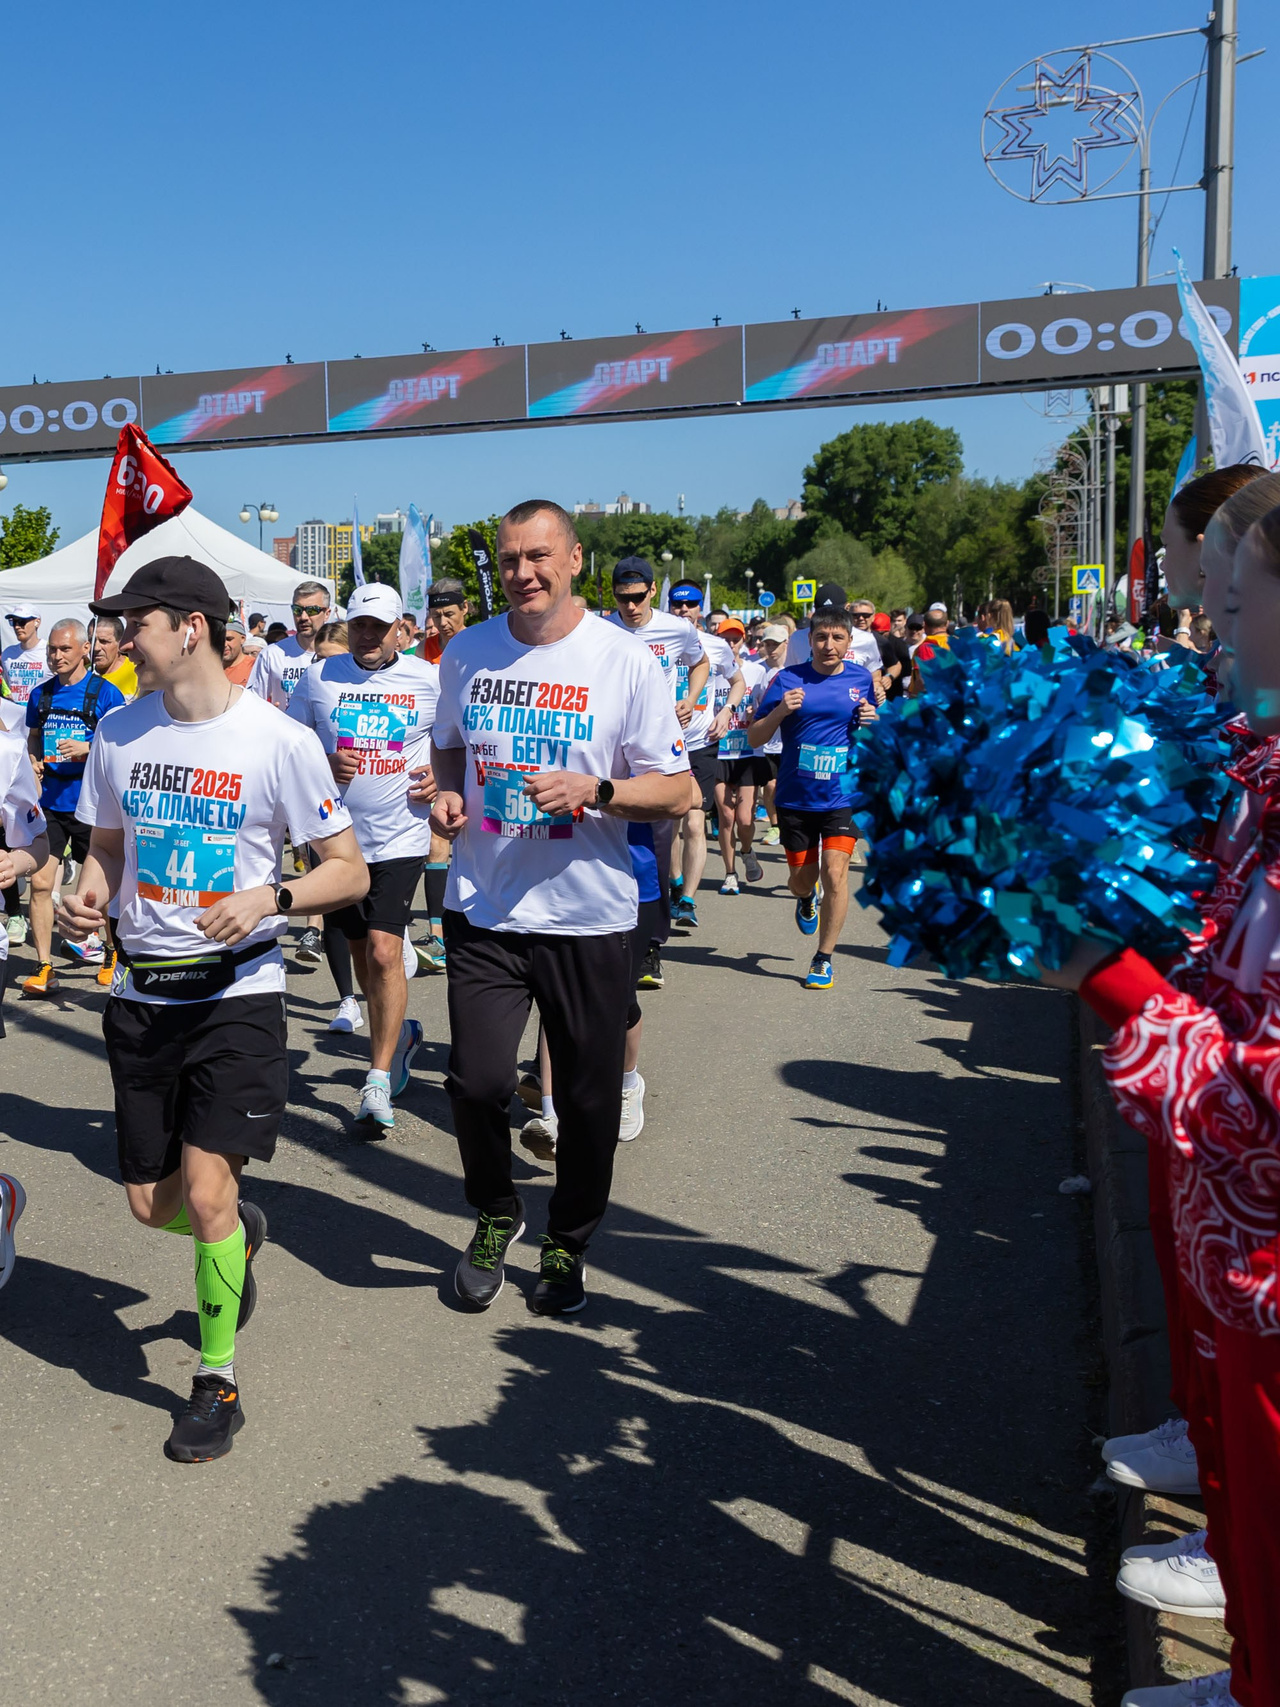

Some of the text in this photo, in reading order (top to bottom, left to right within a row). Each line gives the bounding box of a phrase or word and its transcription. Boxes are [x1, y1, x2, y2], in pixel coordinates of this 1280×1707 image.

[816, 337, 902, 369] СТАРТ
[593, 357, 672, 388] СТАРТ
[1261, 371, 1280, 383] ПС
[388, 374, 460, 402] СТАРТ
[198, 390, 265, 417] СТАРТ
[10, 662, 43, 670] #ЗАБЕГ2025
[18, 670, 44, 678] ПЛАНЕТЫ
[22, 678, 37, 686] БЕГУТ
[470, 678, 589, 712] #ЗАБЕГ2025
[356, 714, 390, 738] 622
[462, 704, 594, 742] 45% ПЛАНЕТЫ
[354, 738, 388, 750] ПСБ 5 КМ
[512, 736, 572, 768] БЕГУТ
[358, 756, 407, 776] С ТОБОЙ
[813, 754, 837, 772] 1171
[129, 762, 243, 802] #ЗАБЕГ2025
[122, 790, 246, 830] 45% ПЛАНЕТЫ
[500, 822, 550, 840] ПСБ 5 КМ
[165, 849, 197, 887] 44
[162, 886, 200, 906] 21.1КМ
[159, 970, 210, 982] DEMIX
